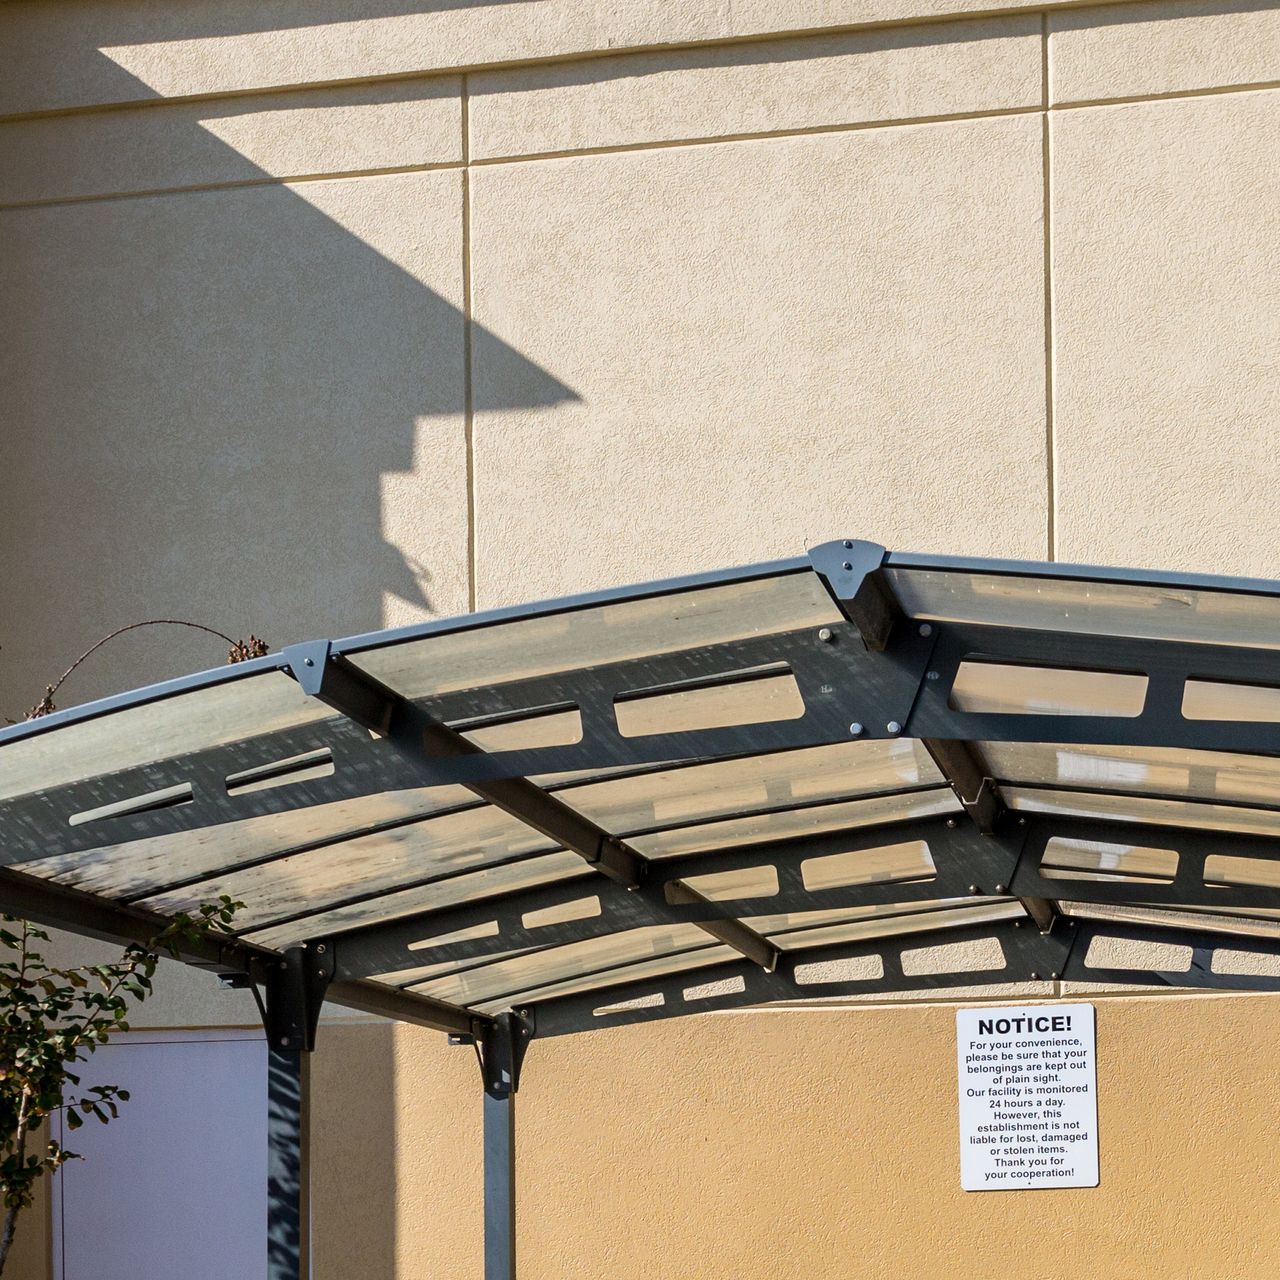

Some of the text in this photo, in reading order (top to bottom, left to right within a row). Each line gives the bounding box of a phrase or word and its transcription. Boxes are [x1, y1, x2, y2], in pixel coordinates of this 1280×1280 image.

[979, 1016, 1071, 1035] NOTICE!
[970, 1038, 1082, 1051] For your convenience,
[966, 1054, 998, 1063] please
[1002, 1052, 1013, 1060] be
[1042, 1050, 1061, 1058] that
[1064, 1050, 1087, 1059] your
[967, 1065, 1023, 1074] belongings
[1045, 1062, 1067, 1071] kept
[1070, 1061, 1086, 1069] out
[993, 1074, 1061, 1085] of plain sight.
[967, 1089, 985, 1097] Our
[988, 1087, 1021, 1097] facility
[1037, 1084, 1088, 1094] monitored
[990, 1100, 1001, 1108] 24
[1045, 1098, 1065, 1108] day.
[994, 1110, 1062, 1120] However, this
[978, 1122, 1048, 1132] establishment
[1064, 1121, 1079, 1129] not
[970, 1132, 1087, 1144] liable for lost, damaged
[1004, 1146, 1034, 1155] stolen
[994, 1157, 1064, 1167] Thank you for
[985, 1168, 1074, 1181] your cooperation!
